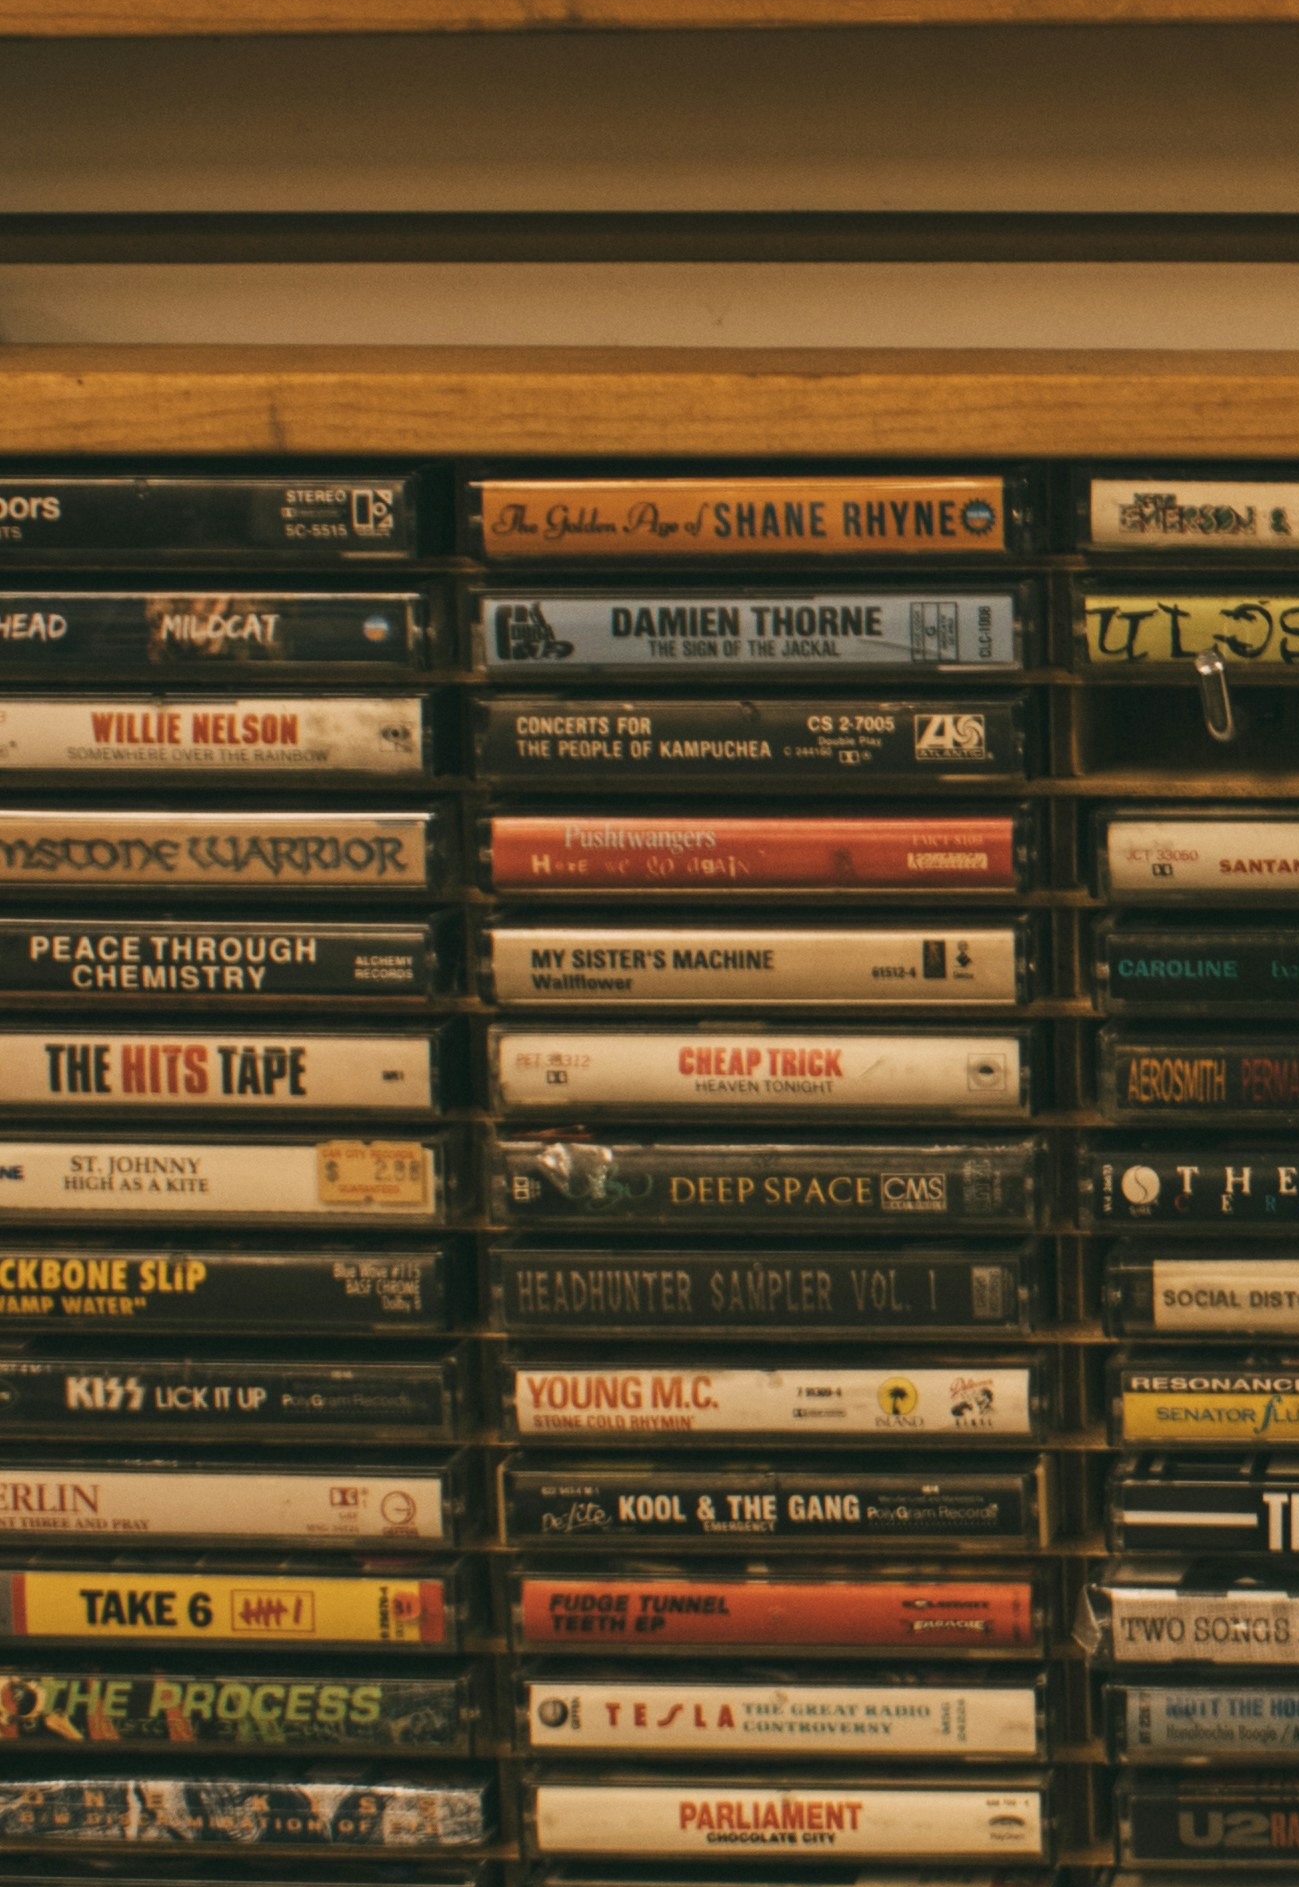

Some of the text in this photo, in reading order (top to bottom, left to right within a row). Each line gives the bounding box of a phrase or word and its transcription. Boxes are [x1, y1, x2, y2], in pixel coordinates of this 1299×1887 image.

[612, 607, 882, 636] DAMIEN THORNE
[92, 713, 299, 744] WILLIE NELSON
[516, 717, 652, 736] CONCERTS FOR
[516, 739, 770, 760] THE PEOPLE OF KAMPUCHEA
[46, 1044, 305, 1095] THE HITS TAPE
[679, 1047, 843, 1077] CHEAP TRICK
[618, 1494, 859, 1522] KOOL & THE GANG
